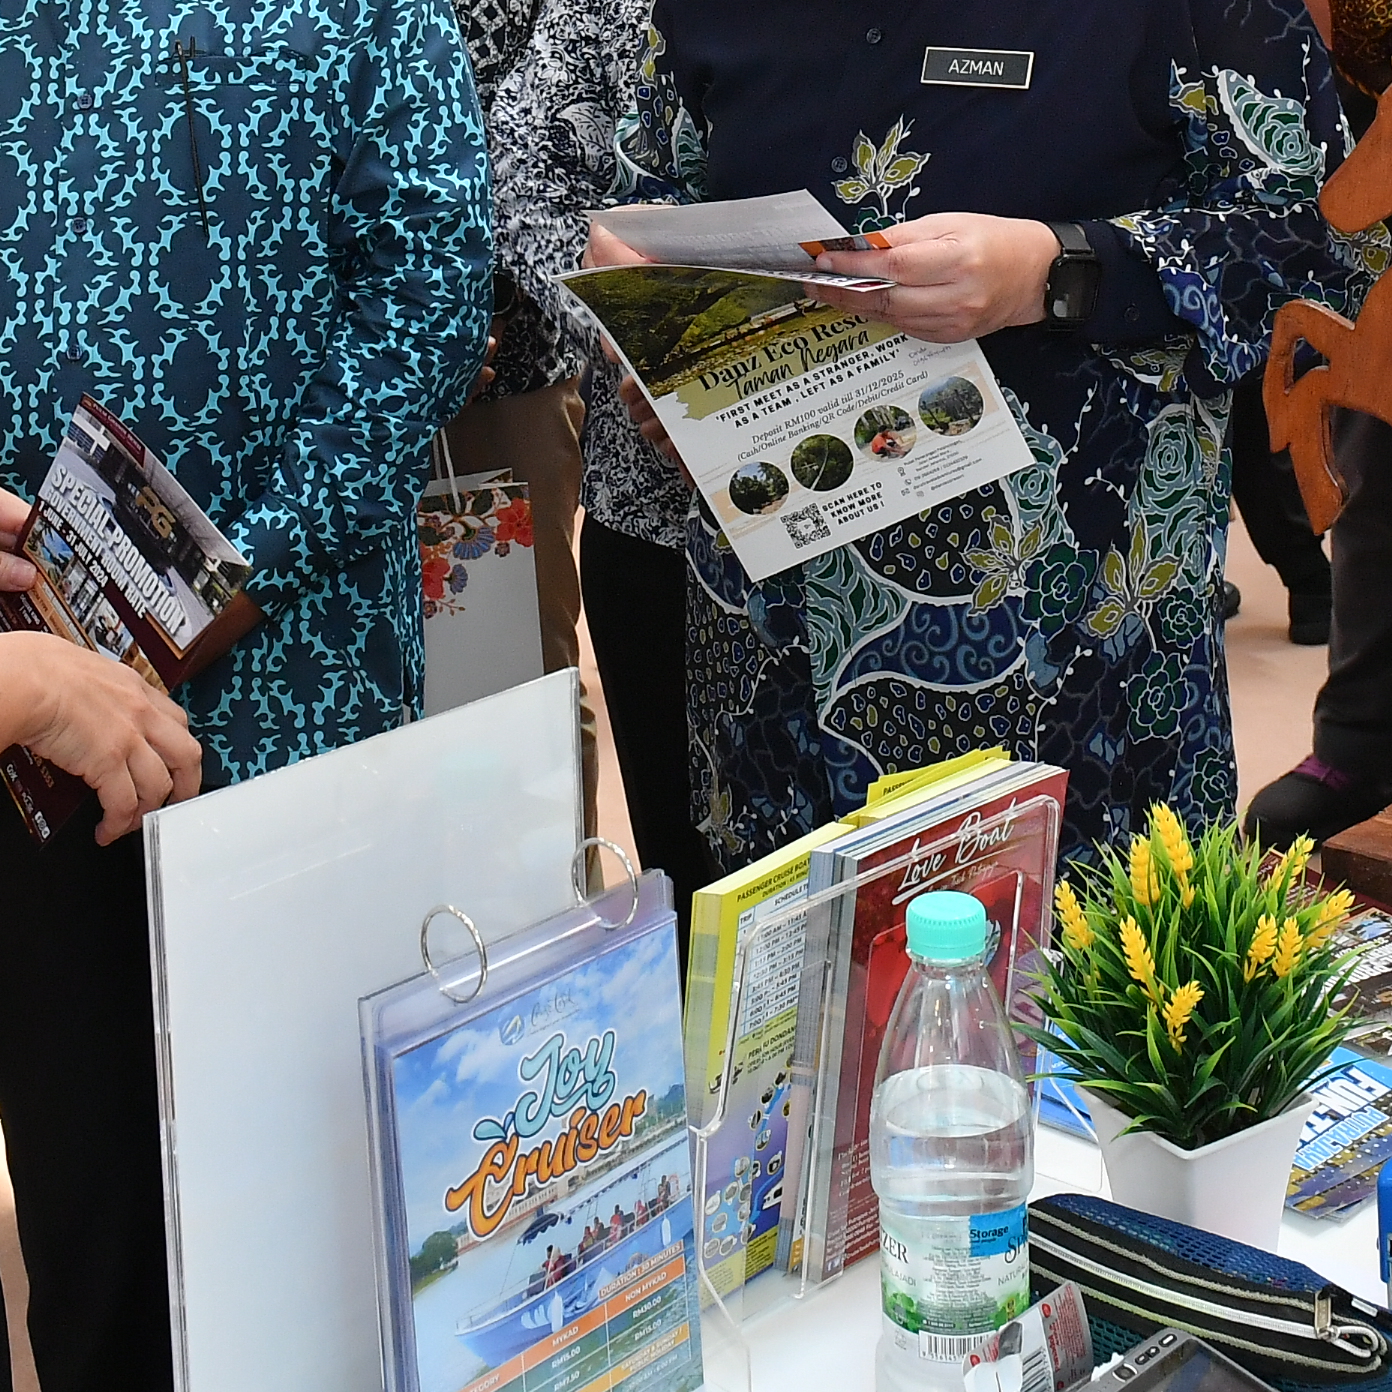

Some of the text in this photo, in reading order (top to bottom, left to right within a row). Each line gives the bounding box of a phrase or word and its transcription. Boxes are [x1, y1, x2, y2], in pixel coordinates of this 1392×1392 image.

[948, 59, 1004, 76] AZMAN
[698, 355, 762, 391] Danz
[762, 338, 809, 363] Eco
[726, 363, 793, 400] Taman
[799, 329, 869, 372] Negara
[754, 389, 782, 407] MEET
[786, 383, 801, 393] AS
[803, 377, 812, 386] A
[813, 352, 875, 381] STRANGER,
[876, 333, 909, 353] WORK
[735, 417, 749, 429] AS
[751, 412, 760, 420] A
[761, 398, 793, 417] TEAM
[801, 384, 826, 399] LEFT
[829, 378, 844, 389] AS
[847, 371, 854, 380] A
[856, 349, 900, 374] FAMILY'
[751, 370, 905, 445] Deposit RM100 valid till 31/12/2025
[737, 370, 929, 462] (Cash/Online Banking/QR Code/Debit/Credit Card)
[822, 481, 882, 514] SCAN HERE TO
[830, 492, 883, 518] KNOW MORE
[837, 504, 878, 526] ABOUT US
[43, 507, 108, 587] JUNE 31 JULY 2024
[45, 489, 146, 619] GOVERNMENT ROOM RATE
[52, 467, 109, 538] SPECIAL
[108, 522, 188, 634] PROMOTION
[897, 838, 947, 891] Love
[955, 797, 1017, 864] Boat
[737, 866, 794, 902] PASSENGER CRUISE
[774, 890, 803, 906] SCHEDULE
[740, 913, 752, 925] TRIP
[513, 1029, 616, 1139] Joy
[445, 1089, 647, 1238] Cruiser
[970, 1226, 1009, 1239] Storage
[600, 1271, 637, 1297] DURATION
[651, 1243, 682, 1268] MINUTES
[625, 1271, 667, 1302] NON MYKAD
[632, 1296, 662, 1318] RM30.00
[551, 1346, 581, 1369] RM15.00
[552, 1326, 579, 1347] MYKAD
[554, 1371, 580, 1392] RM7.50
